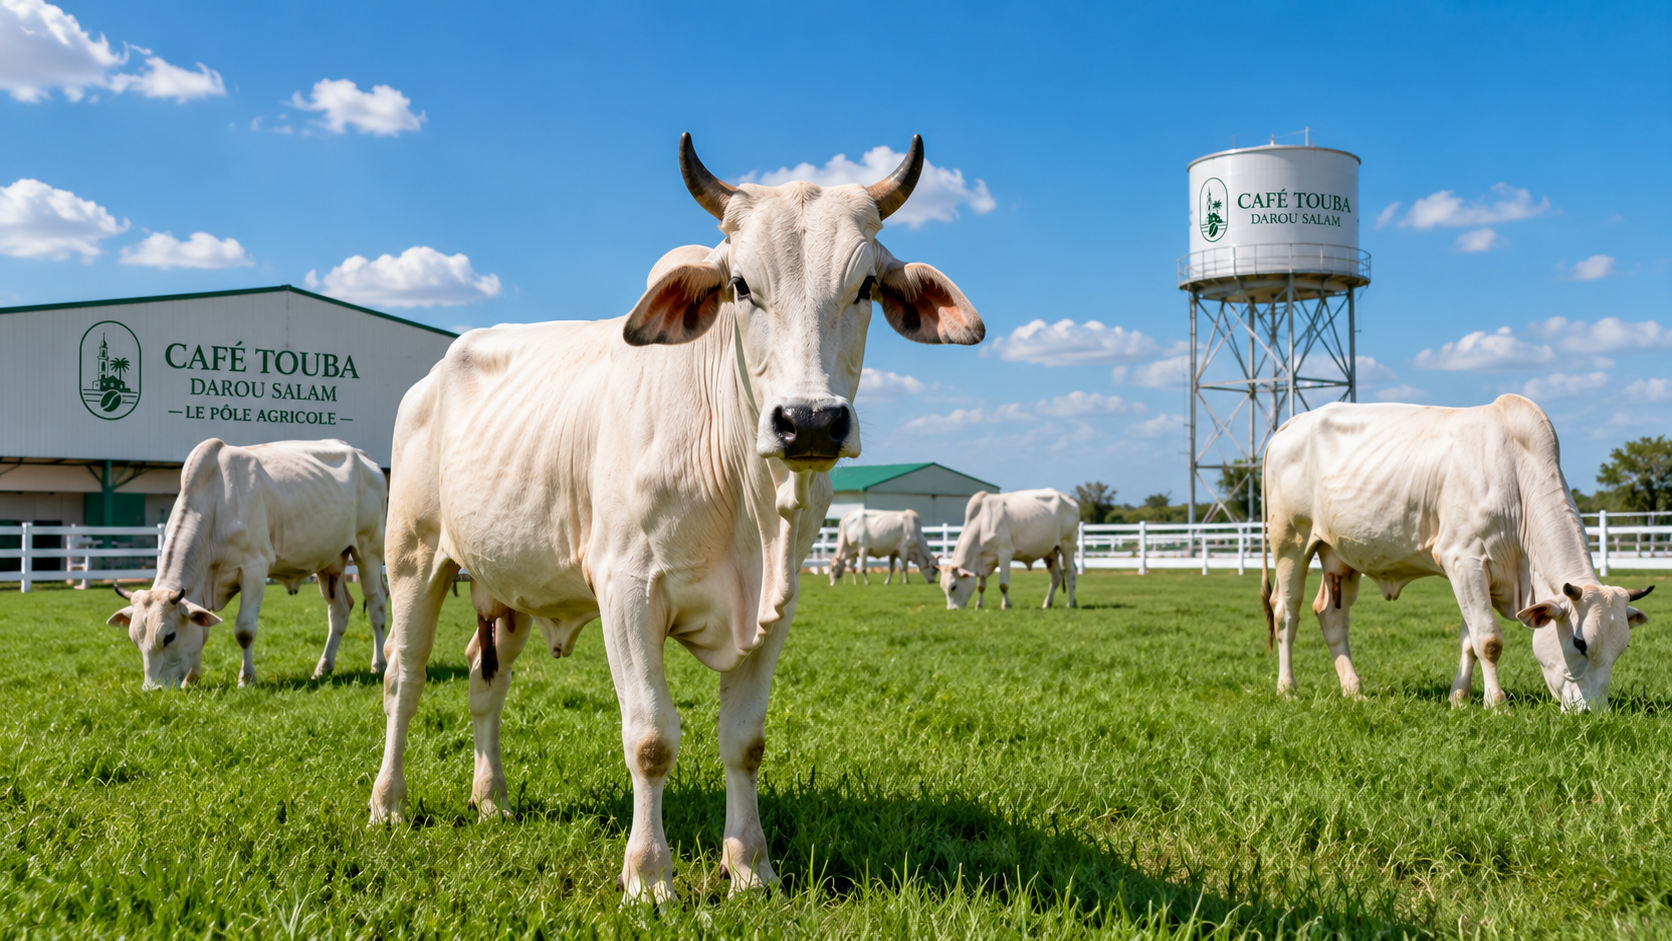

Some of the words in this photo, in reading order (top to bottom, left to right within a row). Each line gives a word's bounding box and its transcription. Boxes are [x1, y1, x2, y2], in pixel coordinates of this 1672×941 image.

[1237, 189, 1288, 209] CAFÉ
[1294, 192, 1351, 213] TOUBA
[1251, 213, 1298, 225] DAROU
[1302, 213, 1341, 227] SALAM
[165, 341, 247, 372] CAFÉ
[255, 348, 360, 379] TOUBA
[190, 377, 265, 398] DAROU
[271, 382, 338, 402] SALAM
[185, 405, 205, 419] LE
[209, 403, 252, 422] PÔLE
[256, 409, 337, 425] AGRICOLE
